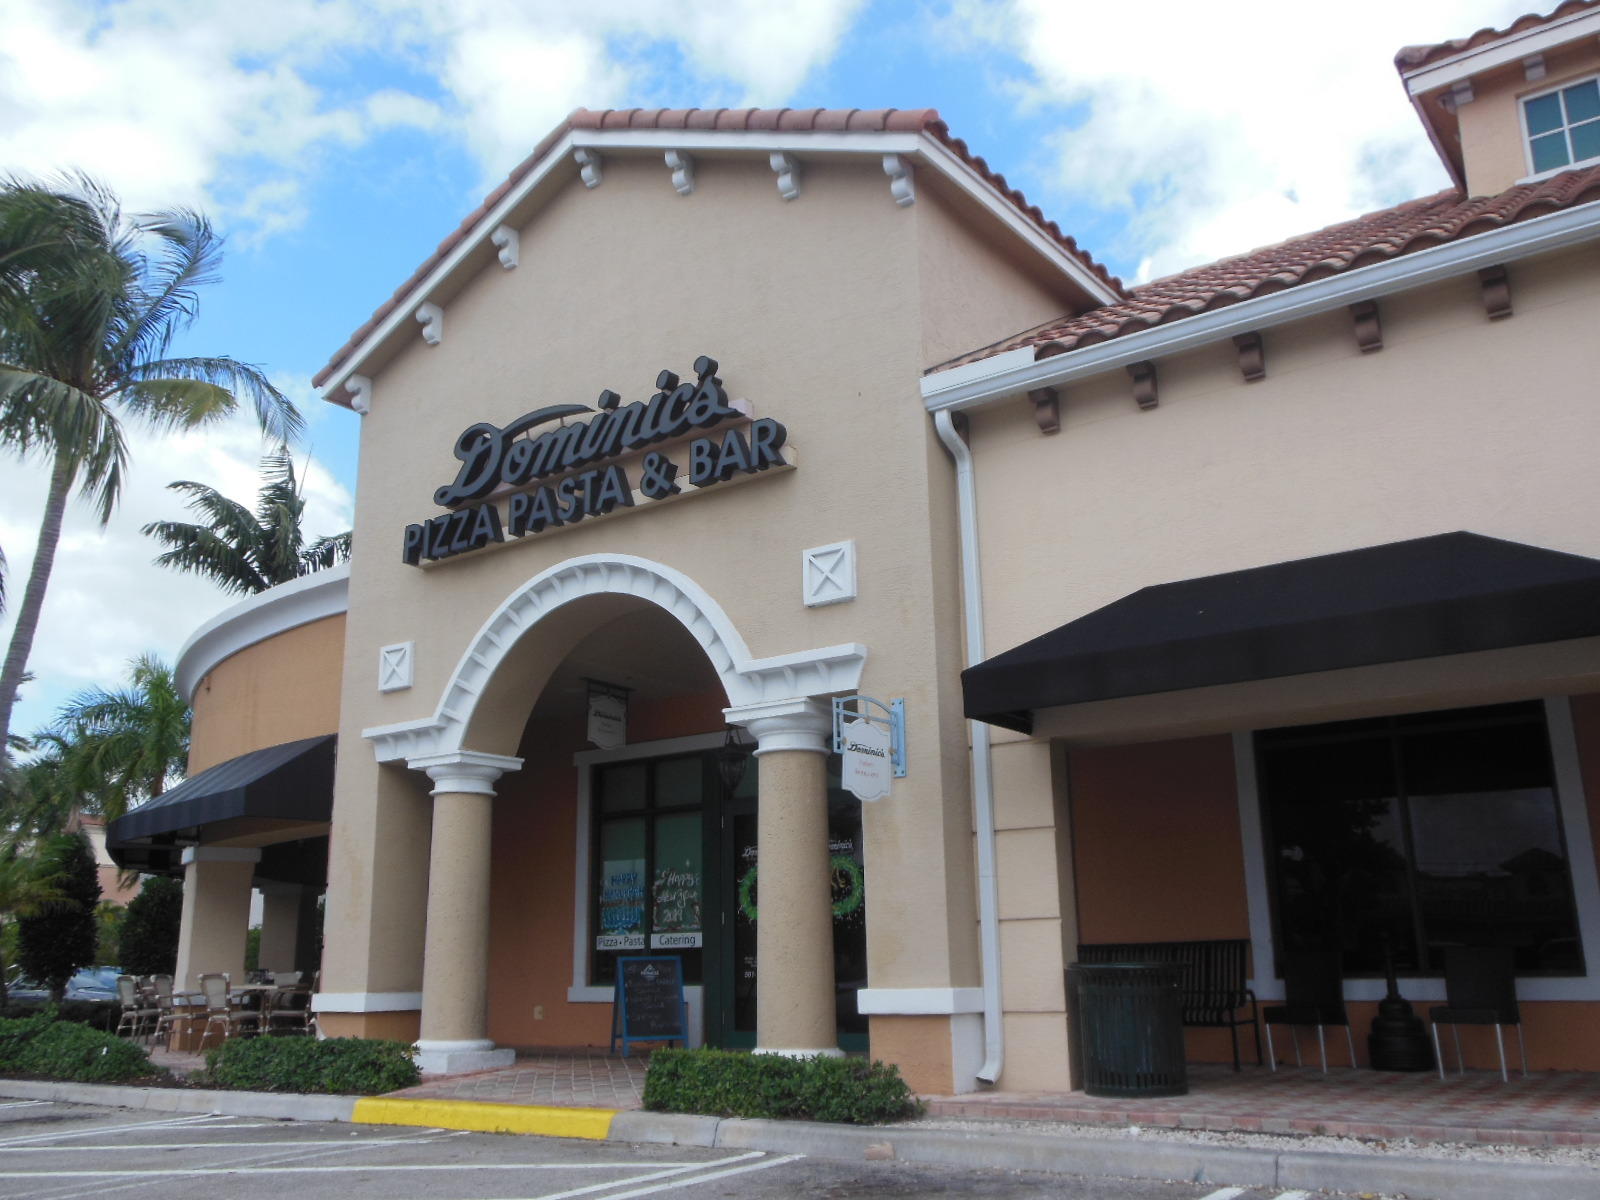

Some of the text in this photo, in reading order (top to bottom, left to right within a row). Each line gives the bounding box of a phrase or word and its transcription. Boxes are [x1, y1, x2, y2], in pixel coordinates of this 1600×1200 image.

[434, 355, 745, 508] Dominic's
[402, 417, 787, 565] PIZZA PASTA & BAR
[847, 742, 886, 758] Dominic's
[659, 934, 696, 947] Catering
